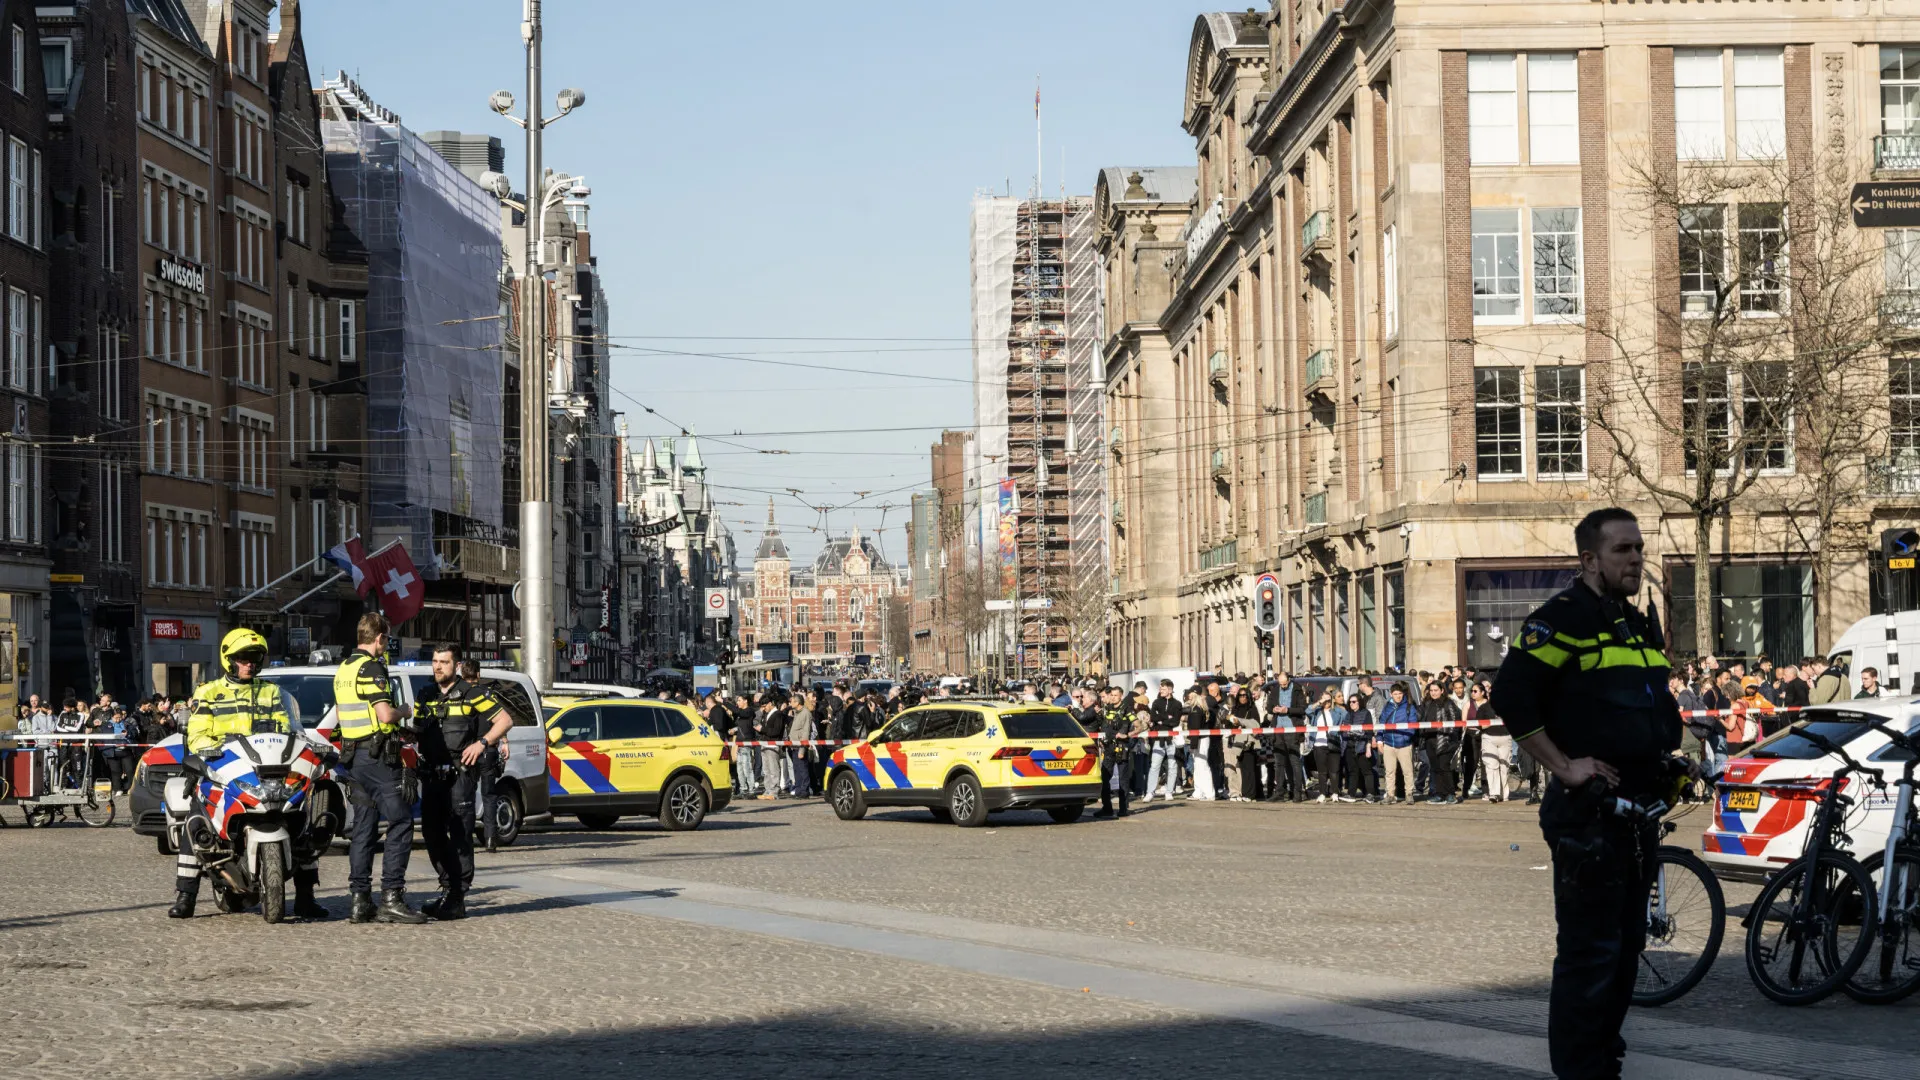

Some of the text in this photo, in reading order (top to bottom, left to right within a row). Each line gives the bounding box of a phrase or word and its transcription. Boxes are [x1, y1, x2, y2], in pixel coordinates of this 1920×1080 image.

[1872, 201, 1884, 209] De
[630, 519, 676, 536] CASINO
[155, 622, 174, 630] TOURS
[155, 628, 178, 636] TICKETS
[254, 737, 284, 745] POITIE
[615, 751, 655, 760] AMBULANCE
